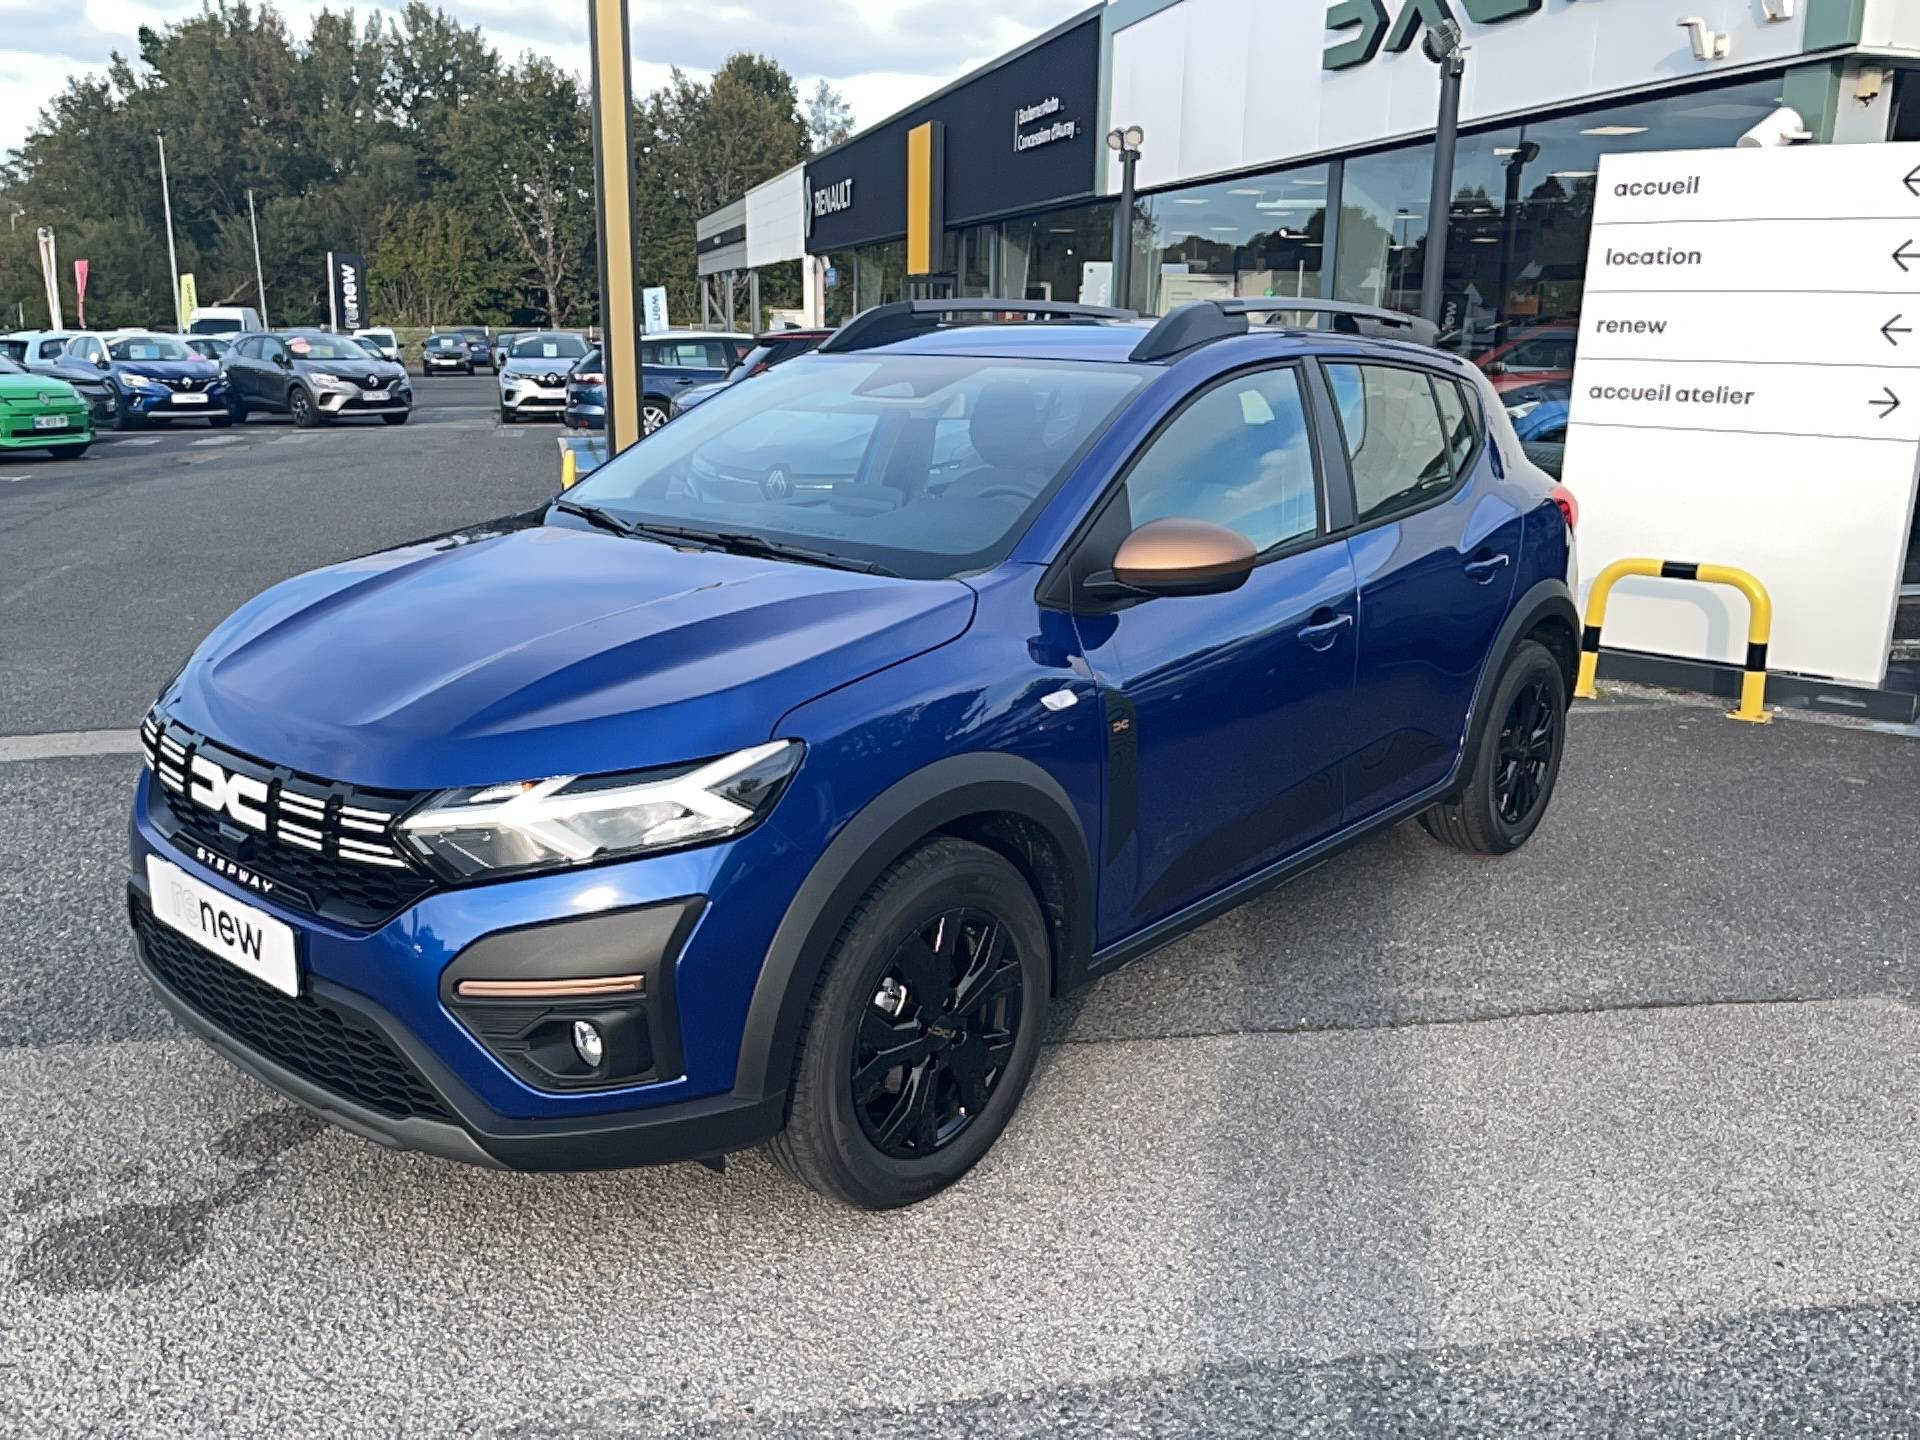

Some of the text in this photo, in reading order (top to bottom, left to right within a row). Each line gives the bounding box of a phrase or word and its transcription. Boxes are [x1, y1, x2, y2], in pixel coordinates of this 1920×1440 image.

[1614, 176, 1700, 197] accueil
[815, 179, 852, 216] RENAULT
[1606, 247, 1702, 266] location
[1596, 319, 1667, 334] renew
[1589, 384, 1755, 405] accueil atelier
[197, 847, 274, 894] STEPWAY
